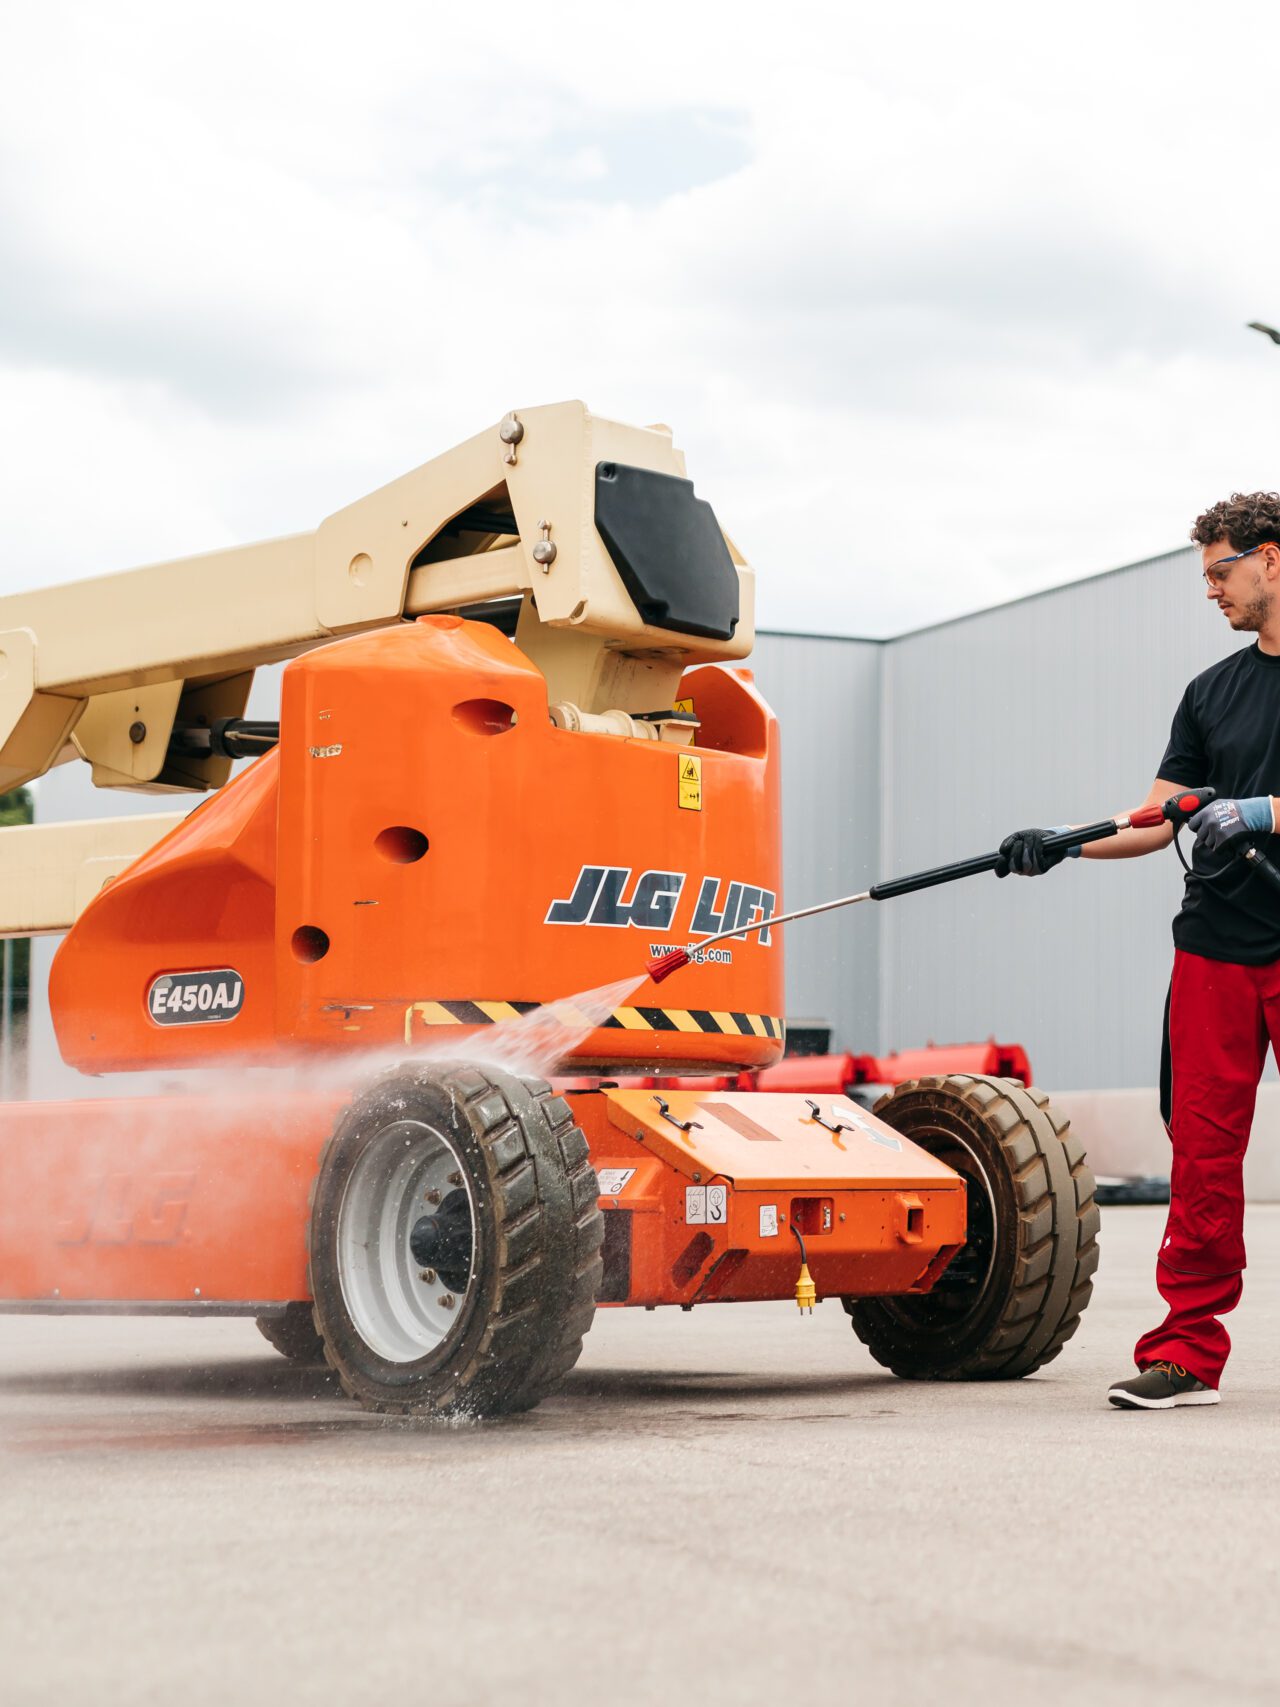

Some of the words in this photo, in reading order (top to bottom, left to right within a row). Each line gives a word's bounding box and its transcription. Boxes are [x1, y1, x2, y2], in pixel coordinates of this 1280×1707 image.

[544, 865, 687, 931] JLG
[688, 876, 777, 946] LIFT
[650, 943, 732, 964] wwg.com
[152, 981, 242, 1014] E450AJ
